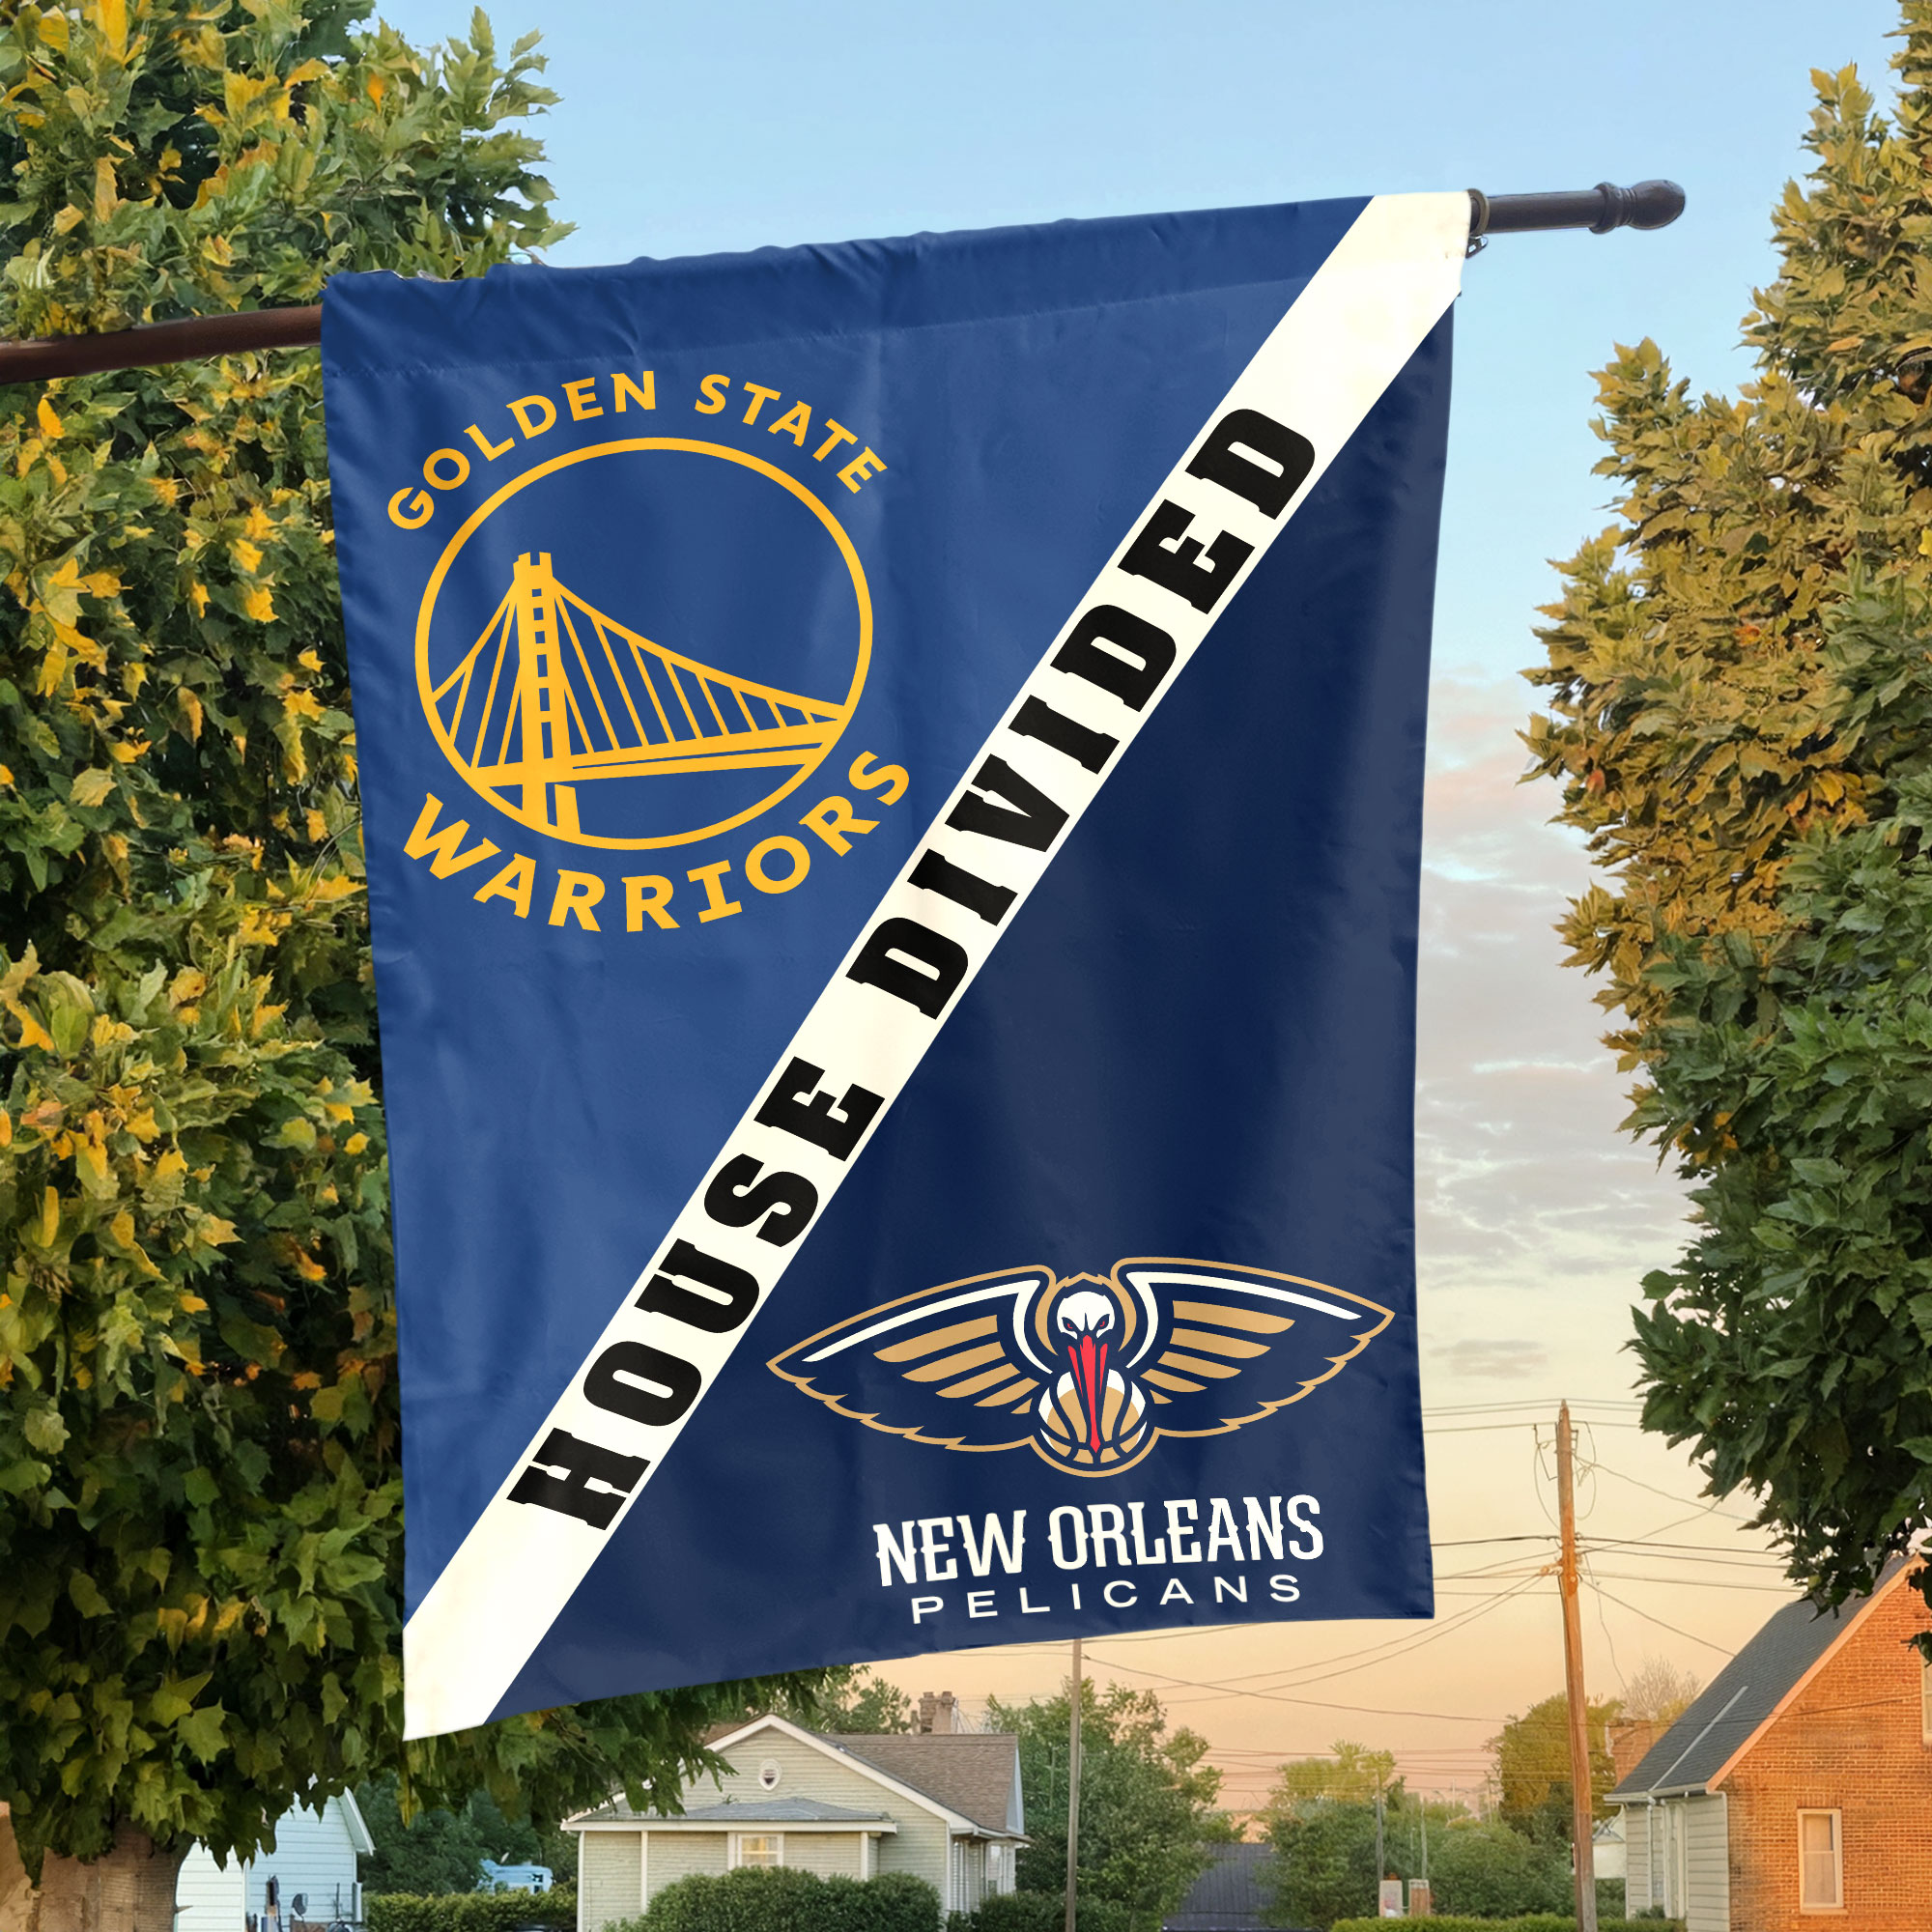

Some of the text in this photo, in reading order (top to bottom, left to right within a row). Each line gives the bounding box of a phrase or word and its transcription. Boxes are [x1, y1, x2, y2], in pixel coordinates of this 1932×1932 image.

[387, 370, 888, 530] GOLDEN STATE
[403, 751, 910, 933] WARRIORS
[508, 409, 1316, 1531] HOUSE DIVIDED
[872, 1493, 1324, 1587] NEW ORLEANS
[910, 1574, 1301, 1625] PELICANS
